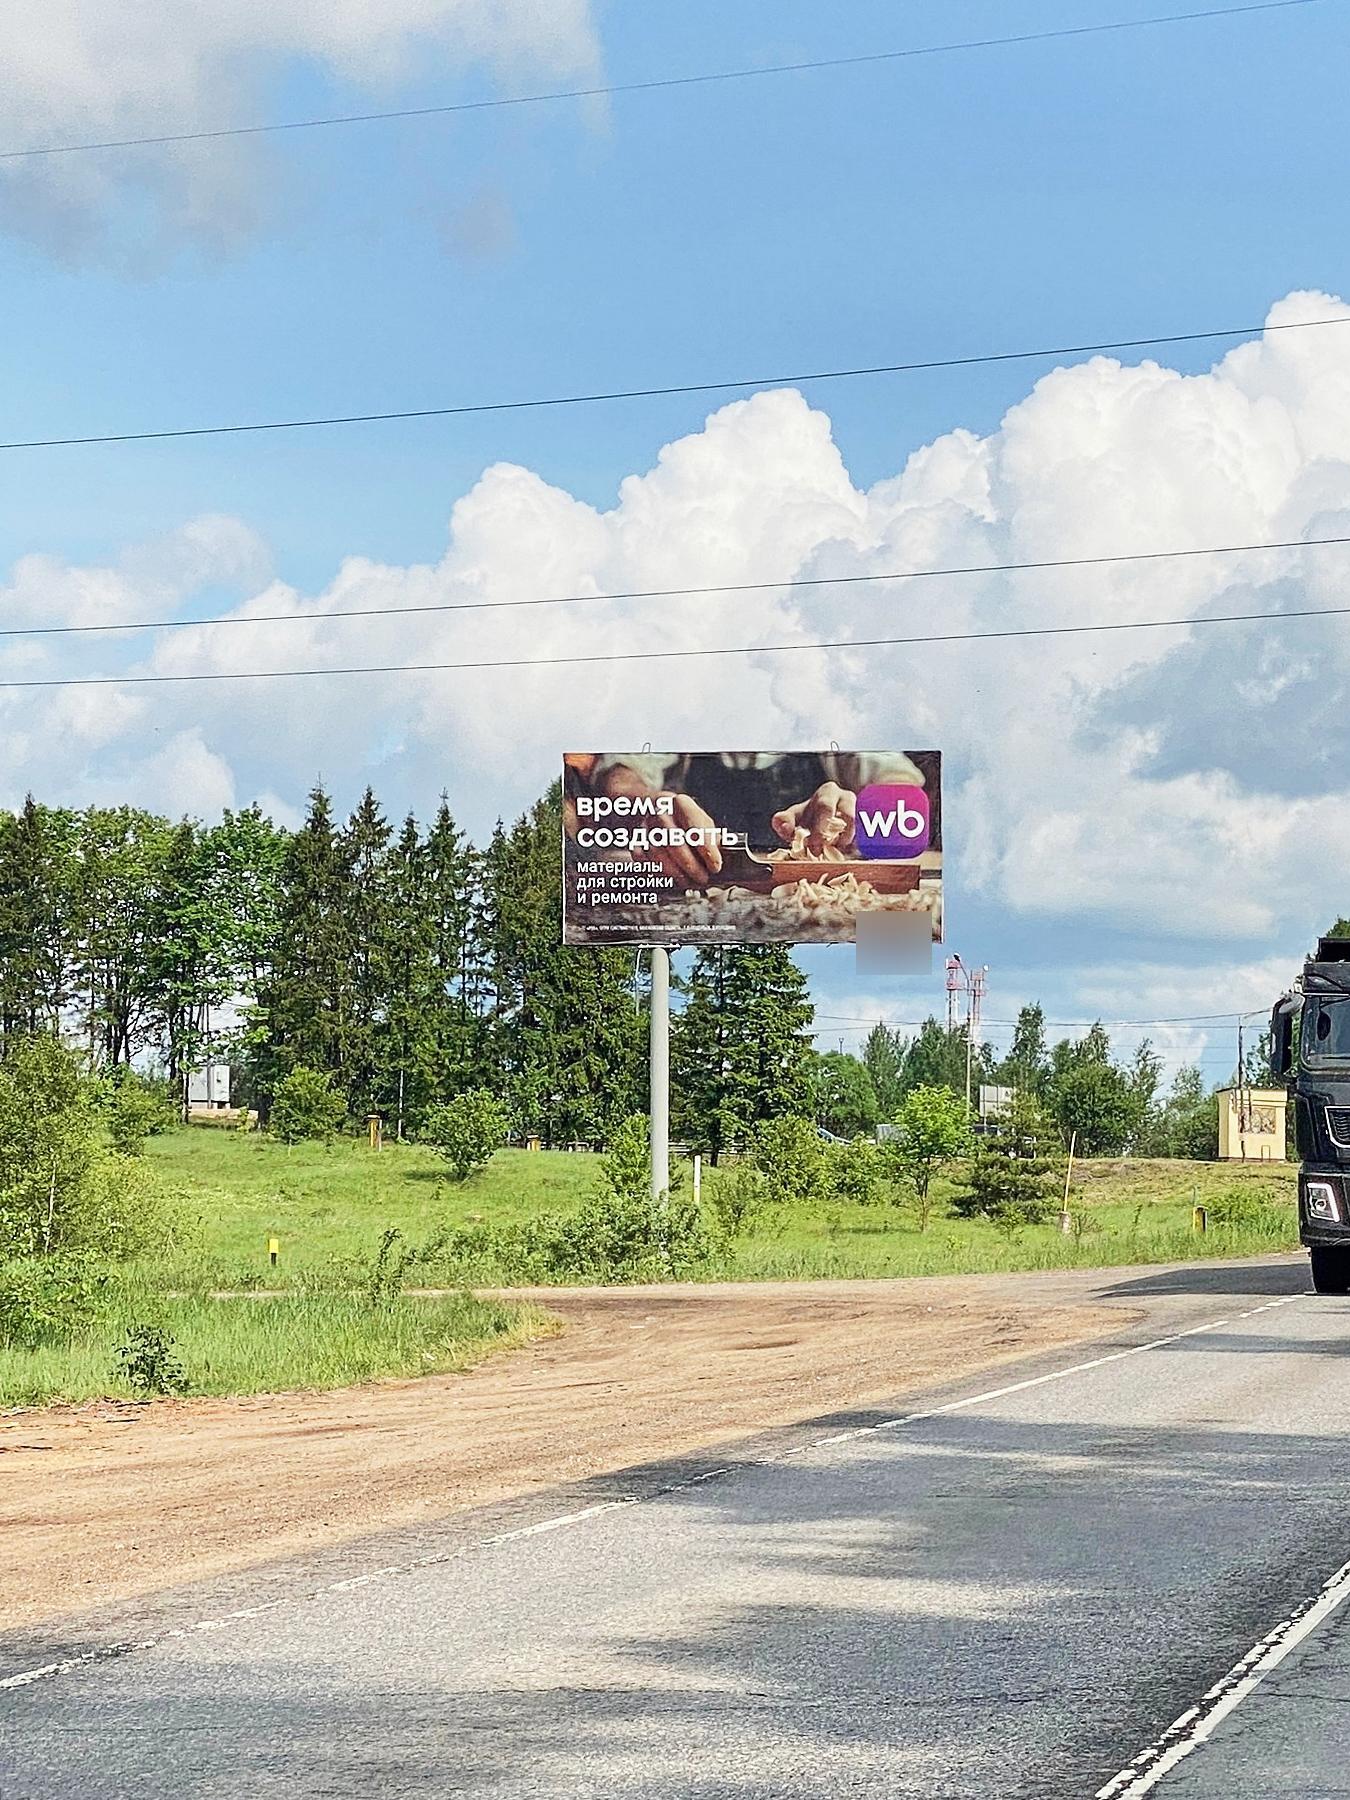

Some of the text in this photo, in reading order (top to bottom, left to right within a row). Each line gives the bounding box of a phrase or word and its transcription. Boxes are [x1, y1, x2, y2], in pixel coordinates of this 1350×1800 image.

[577, 797, 674, 822] время
[858, 799, 925, 838] wb
[577, 827, 739, 851] создавать
[577, 861, 663, 875] материалы
[577, 874, 674, 891] для стройки
[577, 892, 658, 907] и ремонта
